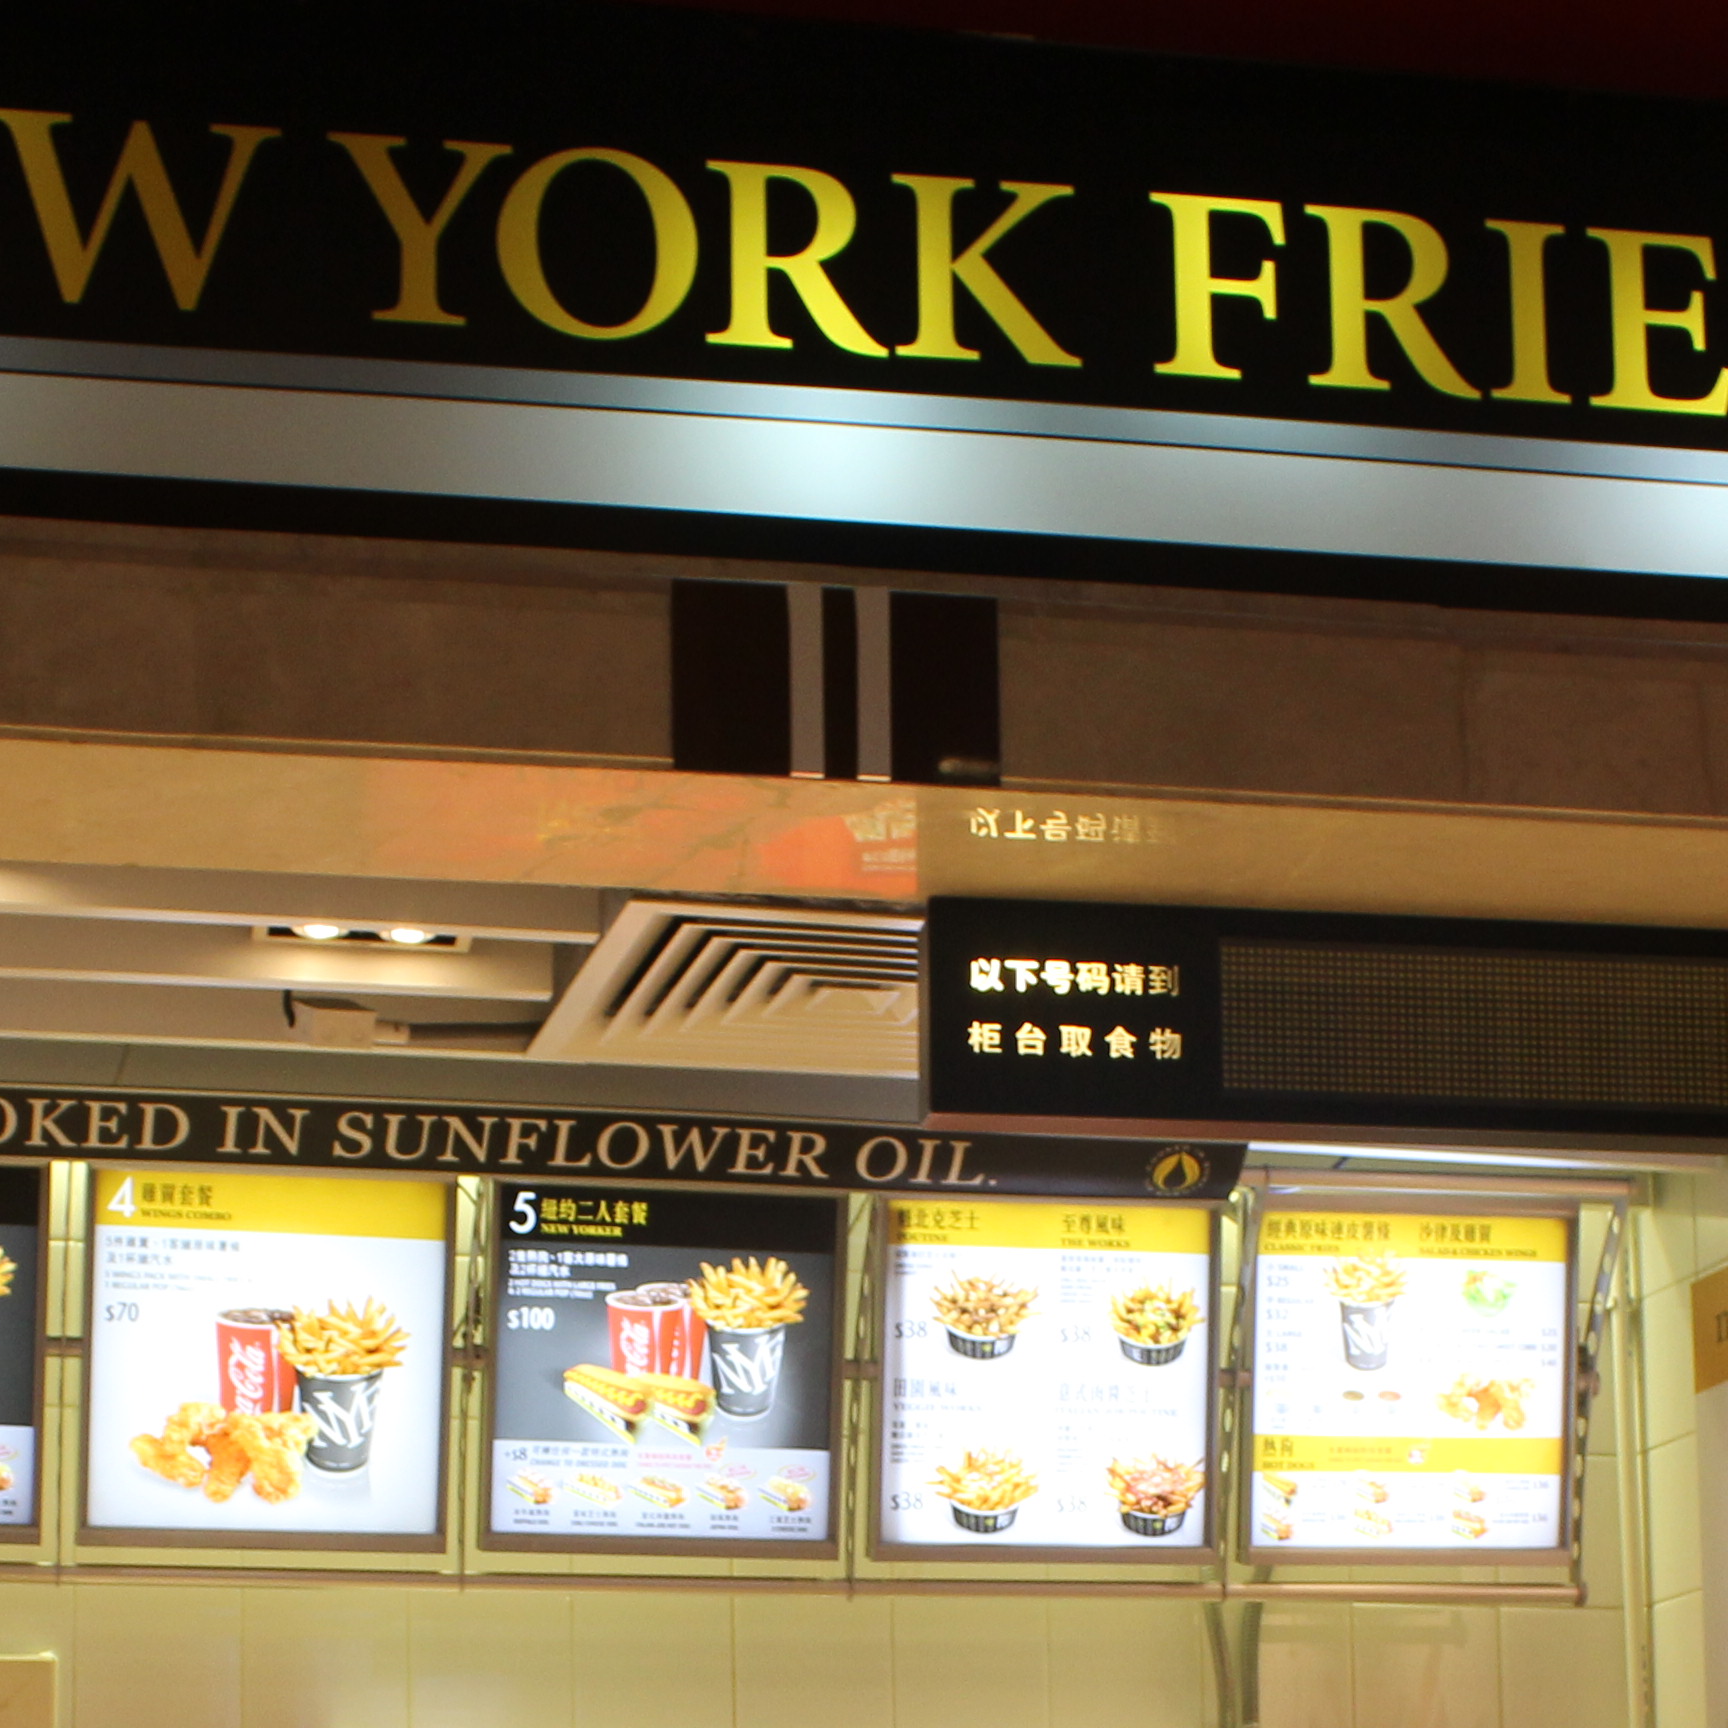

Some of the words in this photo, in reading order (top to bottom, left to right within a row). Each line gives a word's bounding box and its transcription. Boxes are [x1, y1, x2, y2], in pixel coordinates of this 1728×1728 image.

[326, 130, 1083, 368] YORK
[969, 957, 1180, 998] 以下号码请到
[967, 1021, 1183, 1060] 柜台取食物
[215, 1106, 320, 1157] IN
[332, 1109, 828, 1180] SUNFLOWER
[855, 1136, 1000, 1188] OIL.
[107, 1176, 137, 1218] 4
[140, 1208, 183, 1220] WINGS
[185, 1210, 232, 1221] COMBO
[508, 1191, 538, 1234] 5
[541, 1222, 571, 1235] NEW
[573, 1224, 624, 1238] YORKER
[1087, 1239, 1131, 1249] WORKS
[104, 1302, 140, 1323] $70
[507, 1307, 555, 1331] $100
